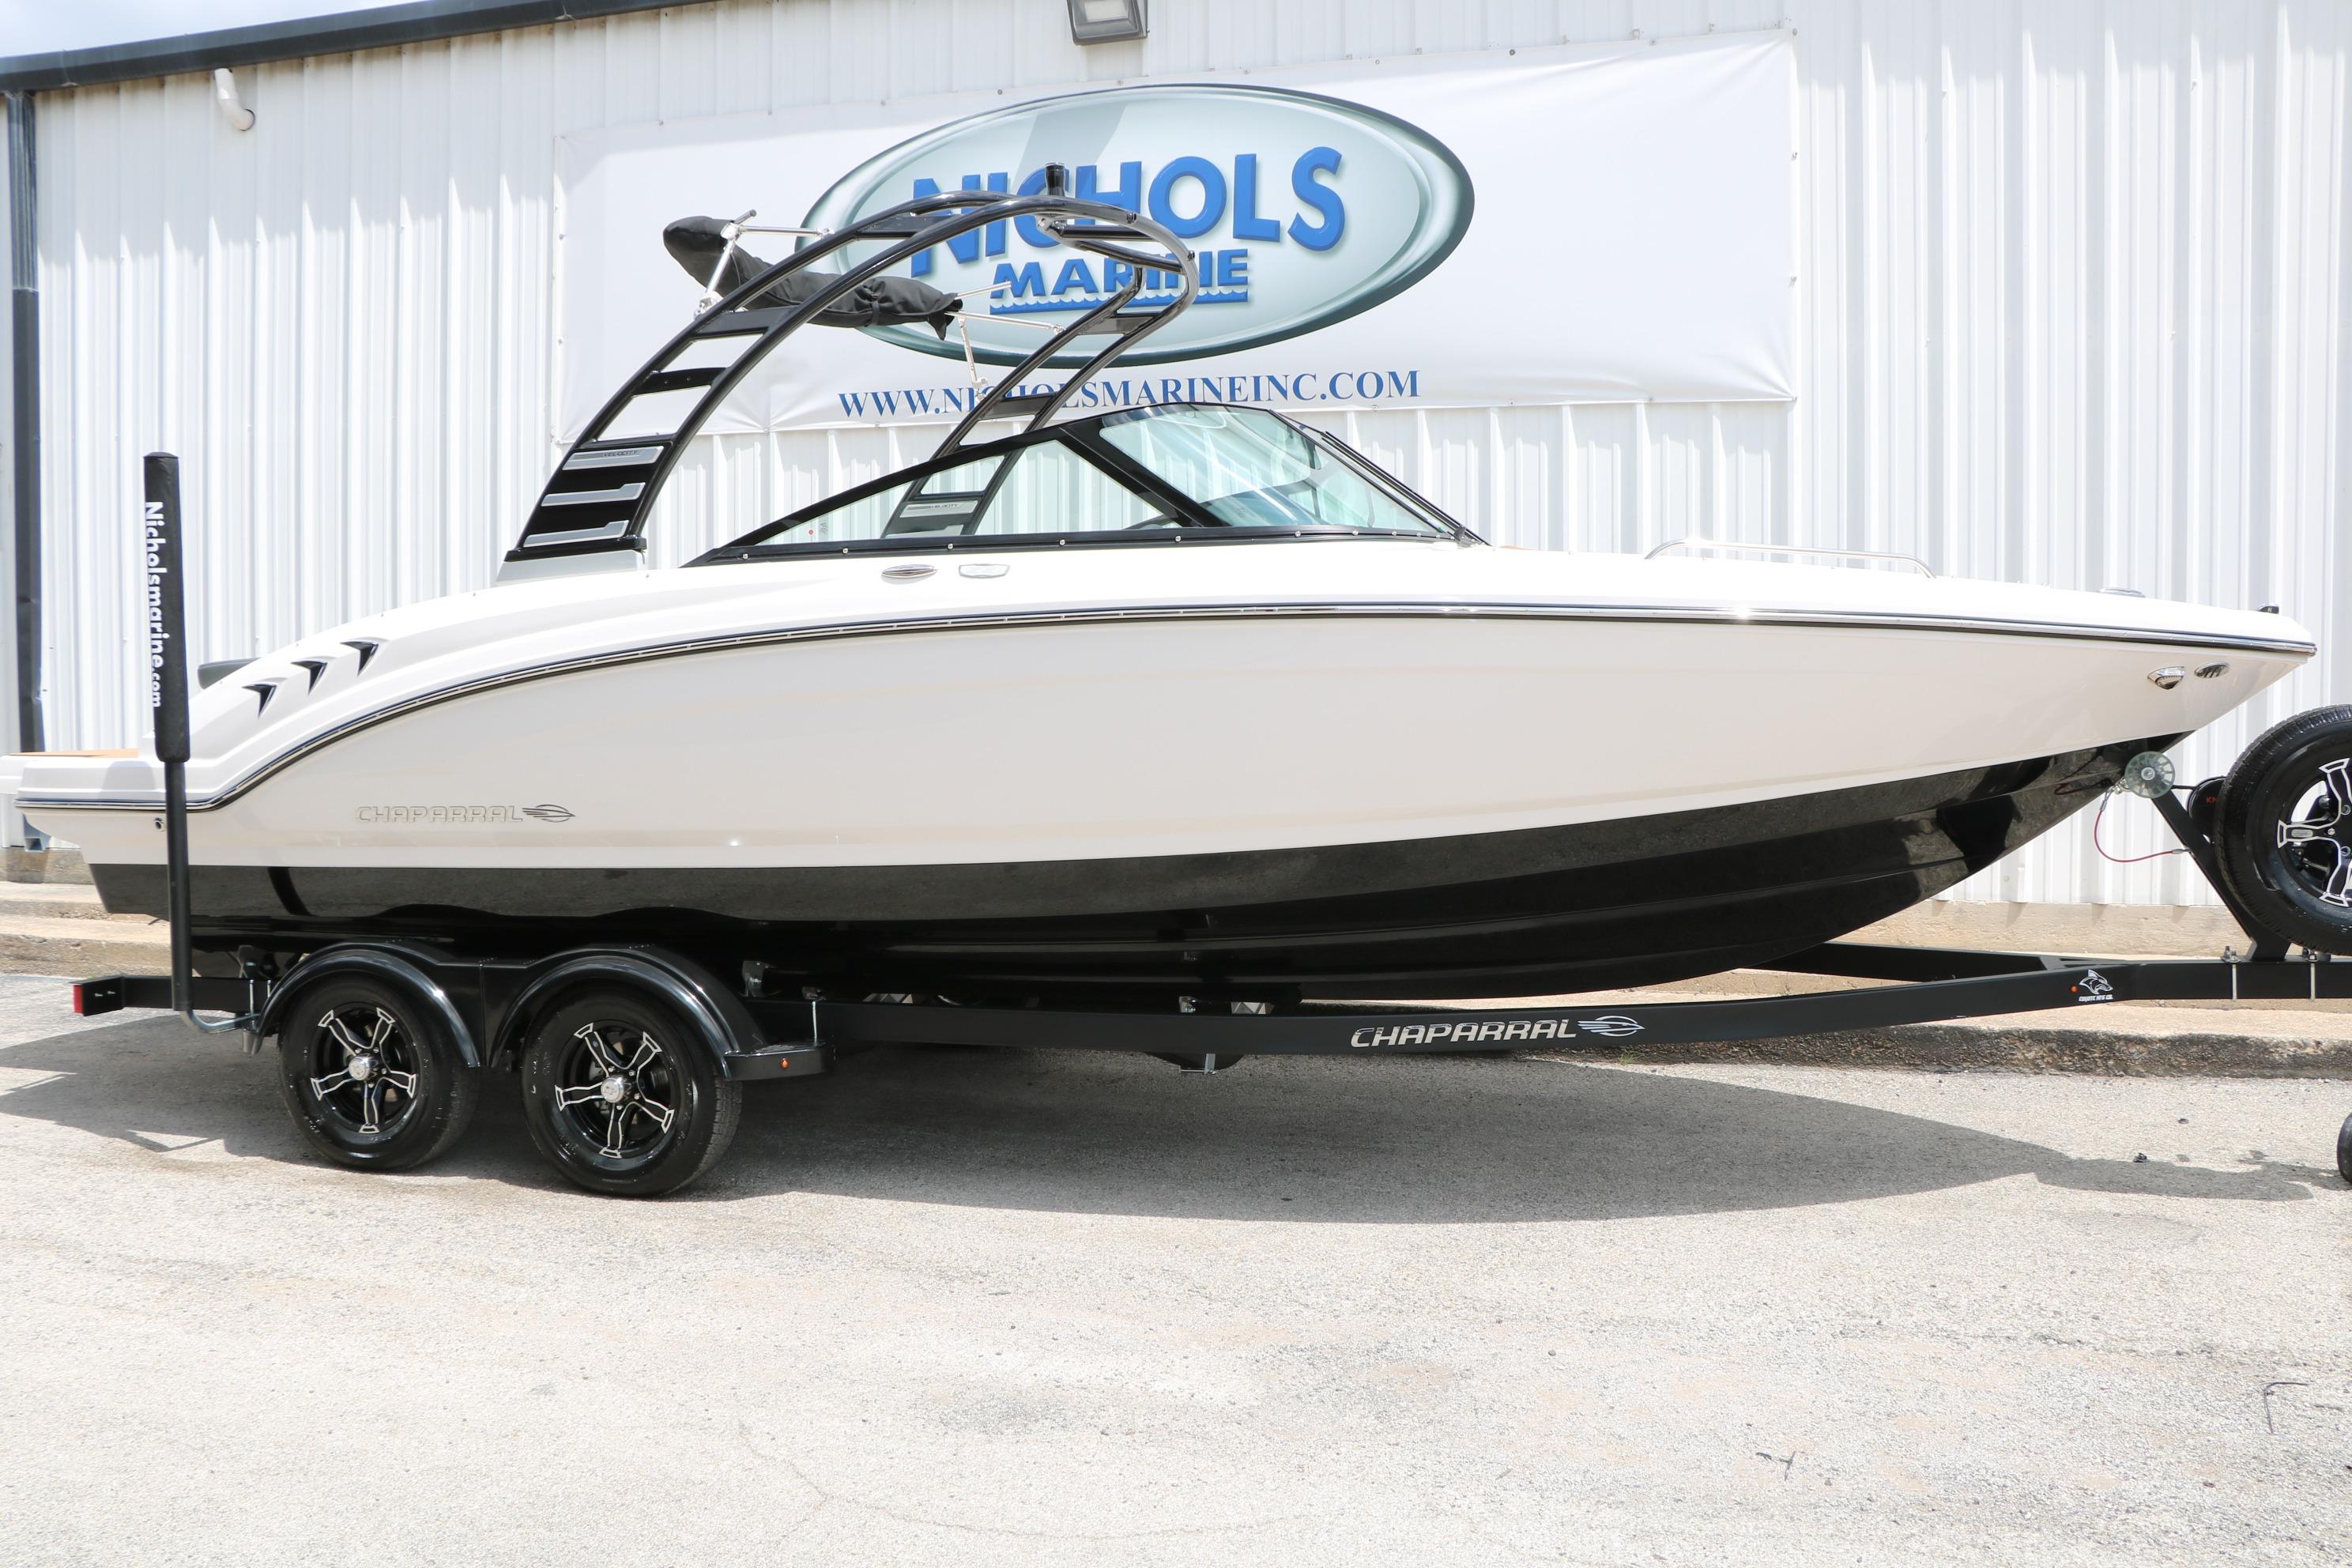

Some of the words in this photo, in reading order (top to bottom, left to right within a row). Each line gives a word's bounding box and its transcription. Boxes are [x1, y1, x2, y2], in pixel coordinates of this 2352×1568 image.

[910, 146, 1346, 278] NICHOLS
[145, 501, 170, 708] Nicholsmarine.com
[355, 805, 524, 823] CHAPARRAL
[1350, 1018, 1577, 1048] CHAPARRAL
